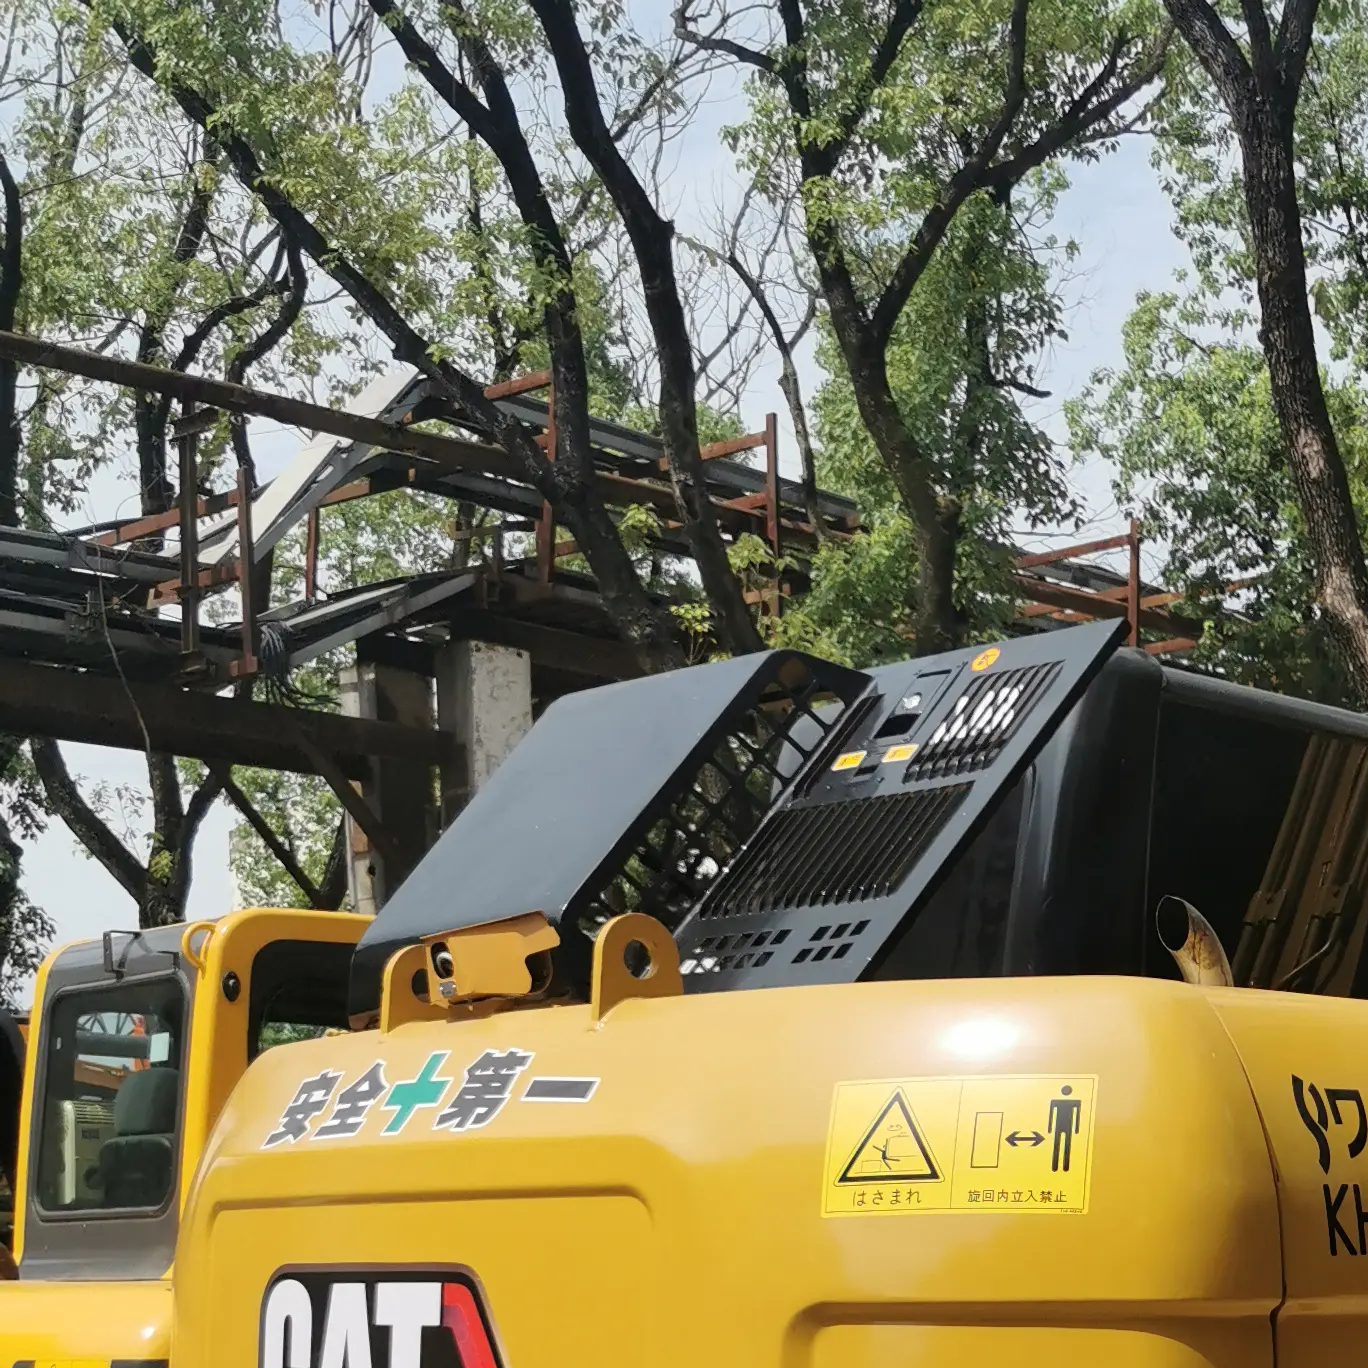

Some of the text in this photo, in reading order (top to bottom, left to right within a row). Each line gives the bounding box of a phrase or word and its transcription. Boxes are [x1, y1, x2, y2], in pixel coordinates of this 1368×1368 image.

[851, 1188, 923, 1207] はさまれ
[966, 1189, 1069, 1204] 旋回内立入禁止
